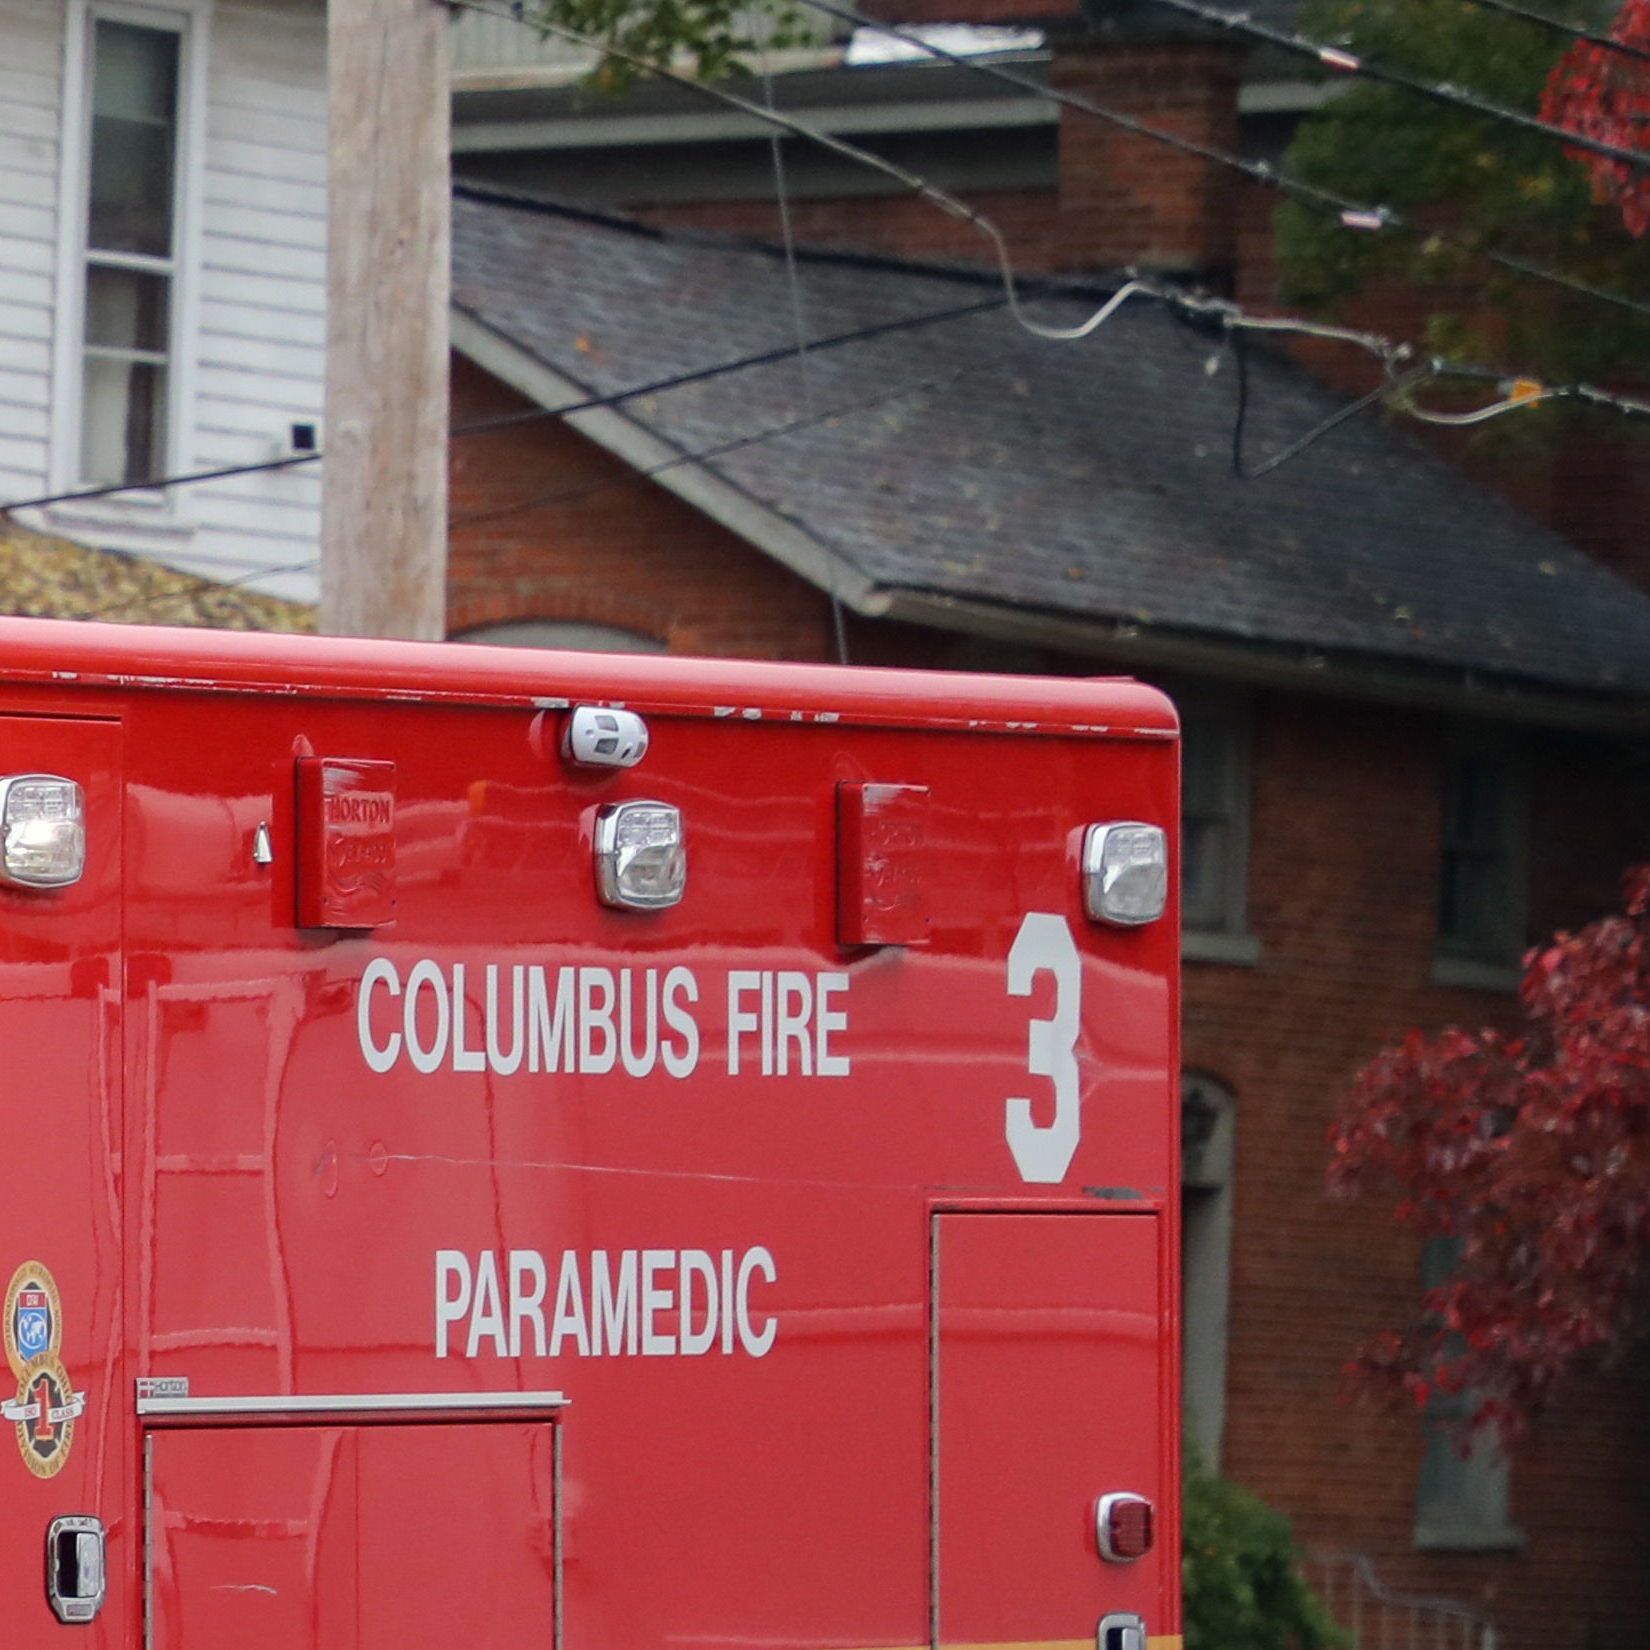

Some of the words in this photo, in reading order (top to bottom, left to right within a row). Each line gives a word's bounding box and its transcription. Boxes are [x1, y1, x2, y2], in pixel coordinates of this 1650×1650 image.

[357, 957, 700, 1079] COLUMBUS
[728, 970, 851, 1077] FIRE
[1006, 912, 1083, 1184] 3
[435, 1246, 778, 1359] PARAMEDIC
